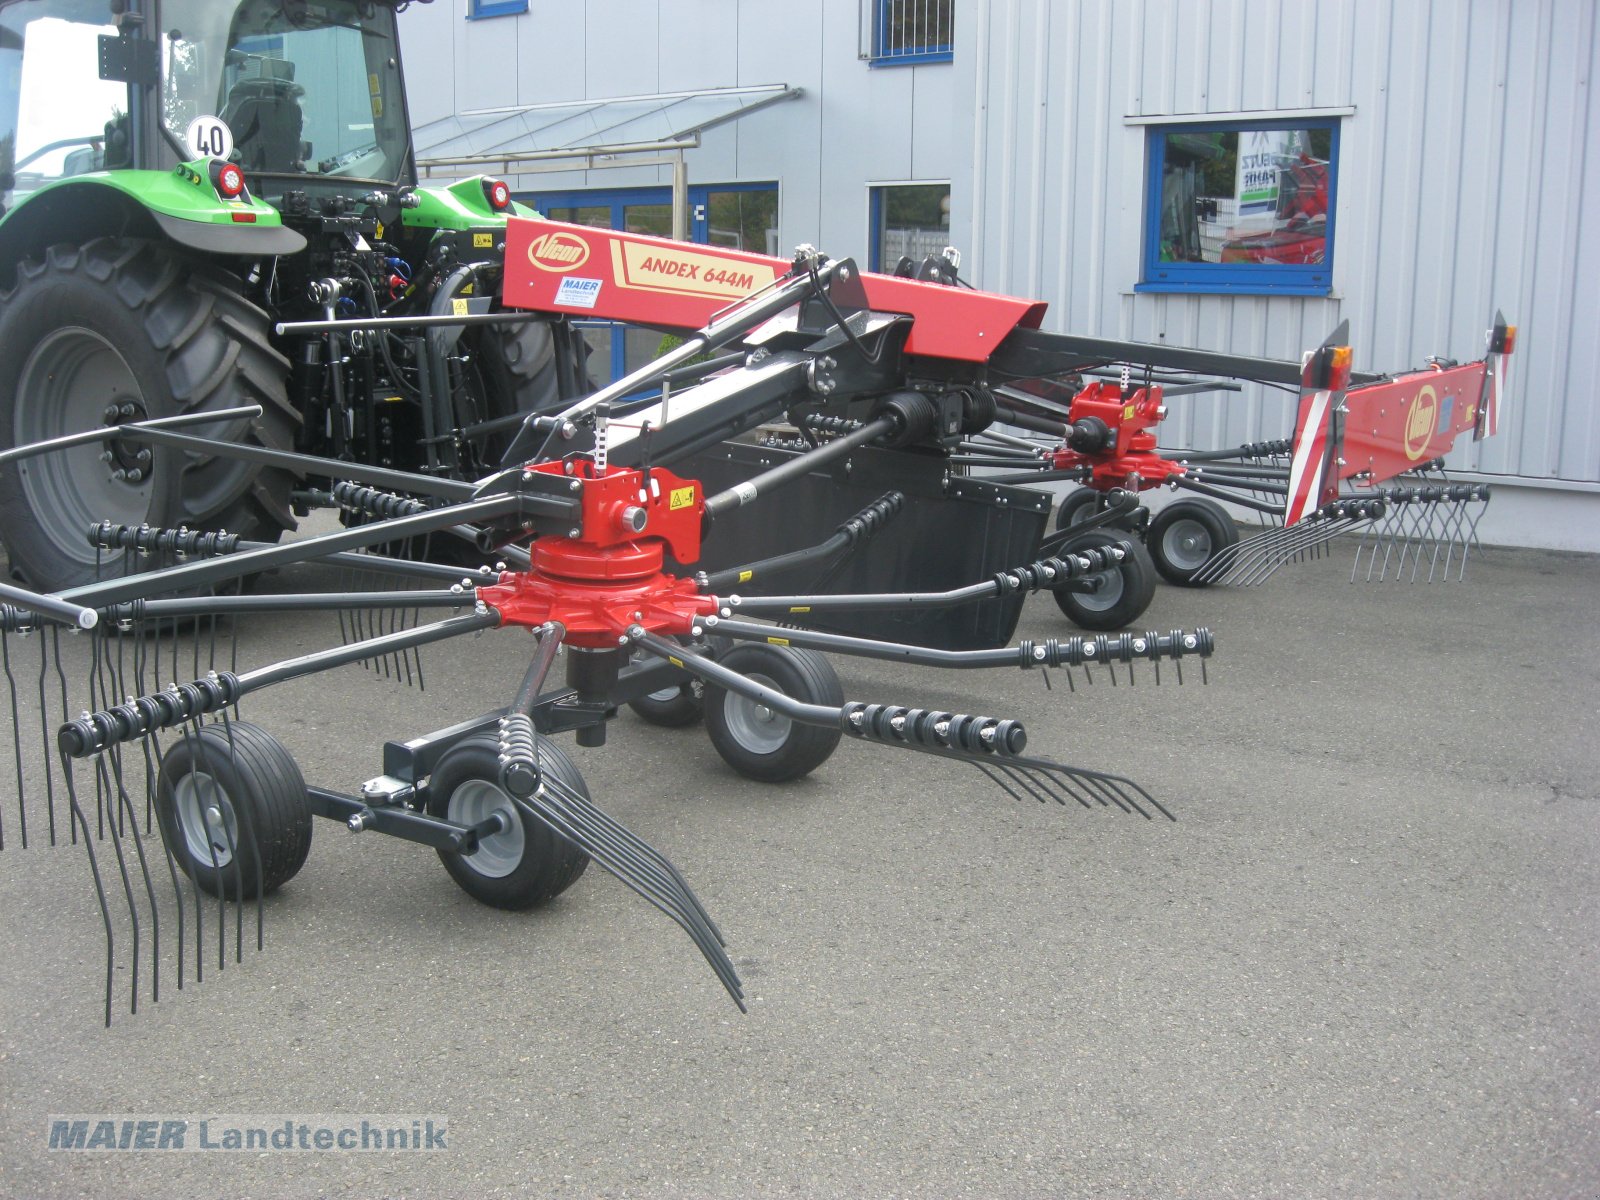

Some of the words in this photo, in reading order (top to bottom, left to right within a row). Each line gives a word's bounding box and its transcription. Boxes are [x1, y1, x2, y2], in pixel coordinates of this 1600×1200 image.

[197, 125, 224, 156] 40
[533, 233, 585, 265] Vicon
[563, 280, 599, 291] MAIER
[640, 257, 700, 280] ANDEX
[703, 268, 754, 290] 644M
